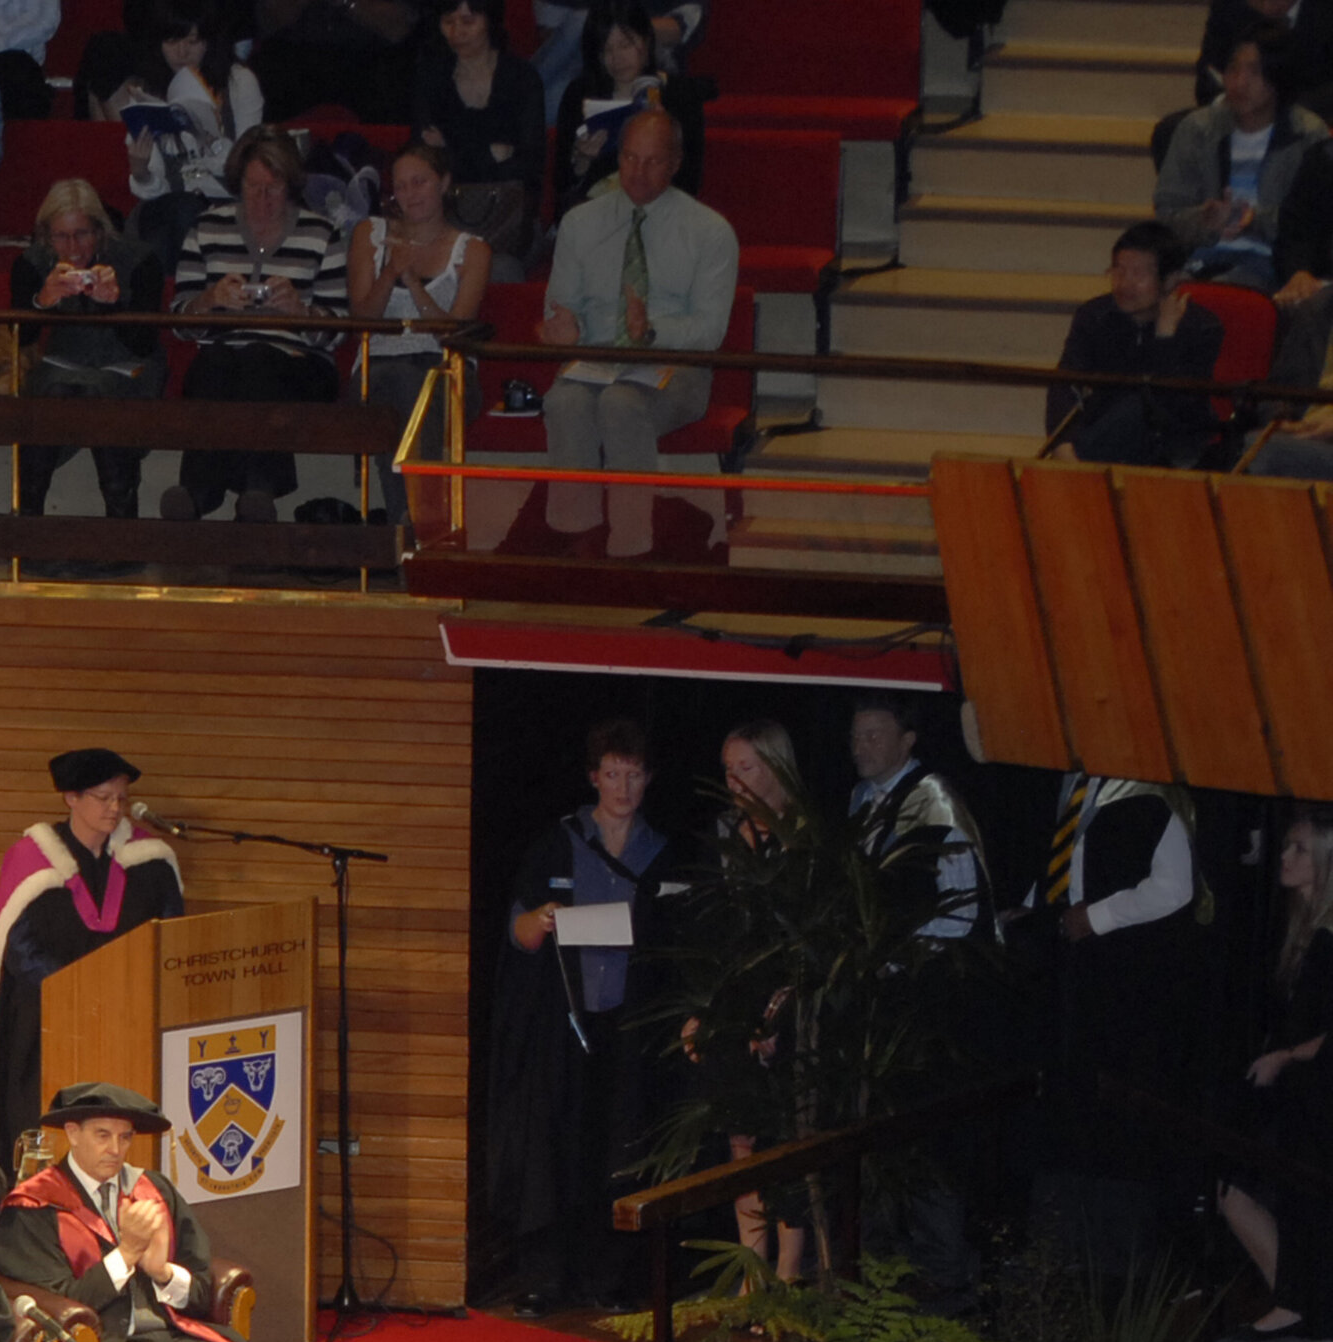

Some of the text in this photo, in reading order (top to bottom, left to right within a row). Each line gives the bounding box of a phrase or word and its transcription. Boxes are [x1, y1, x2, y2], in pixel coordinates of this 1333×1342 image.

[163, 939, 306, 971] CHRISTCHURCH
[181, 961, 289, 987] TOWN HALL
